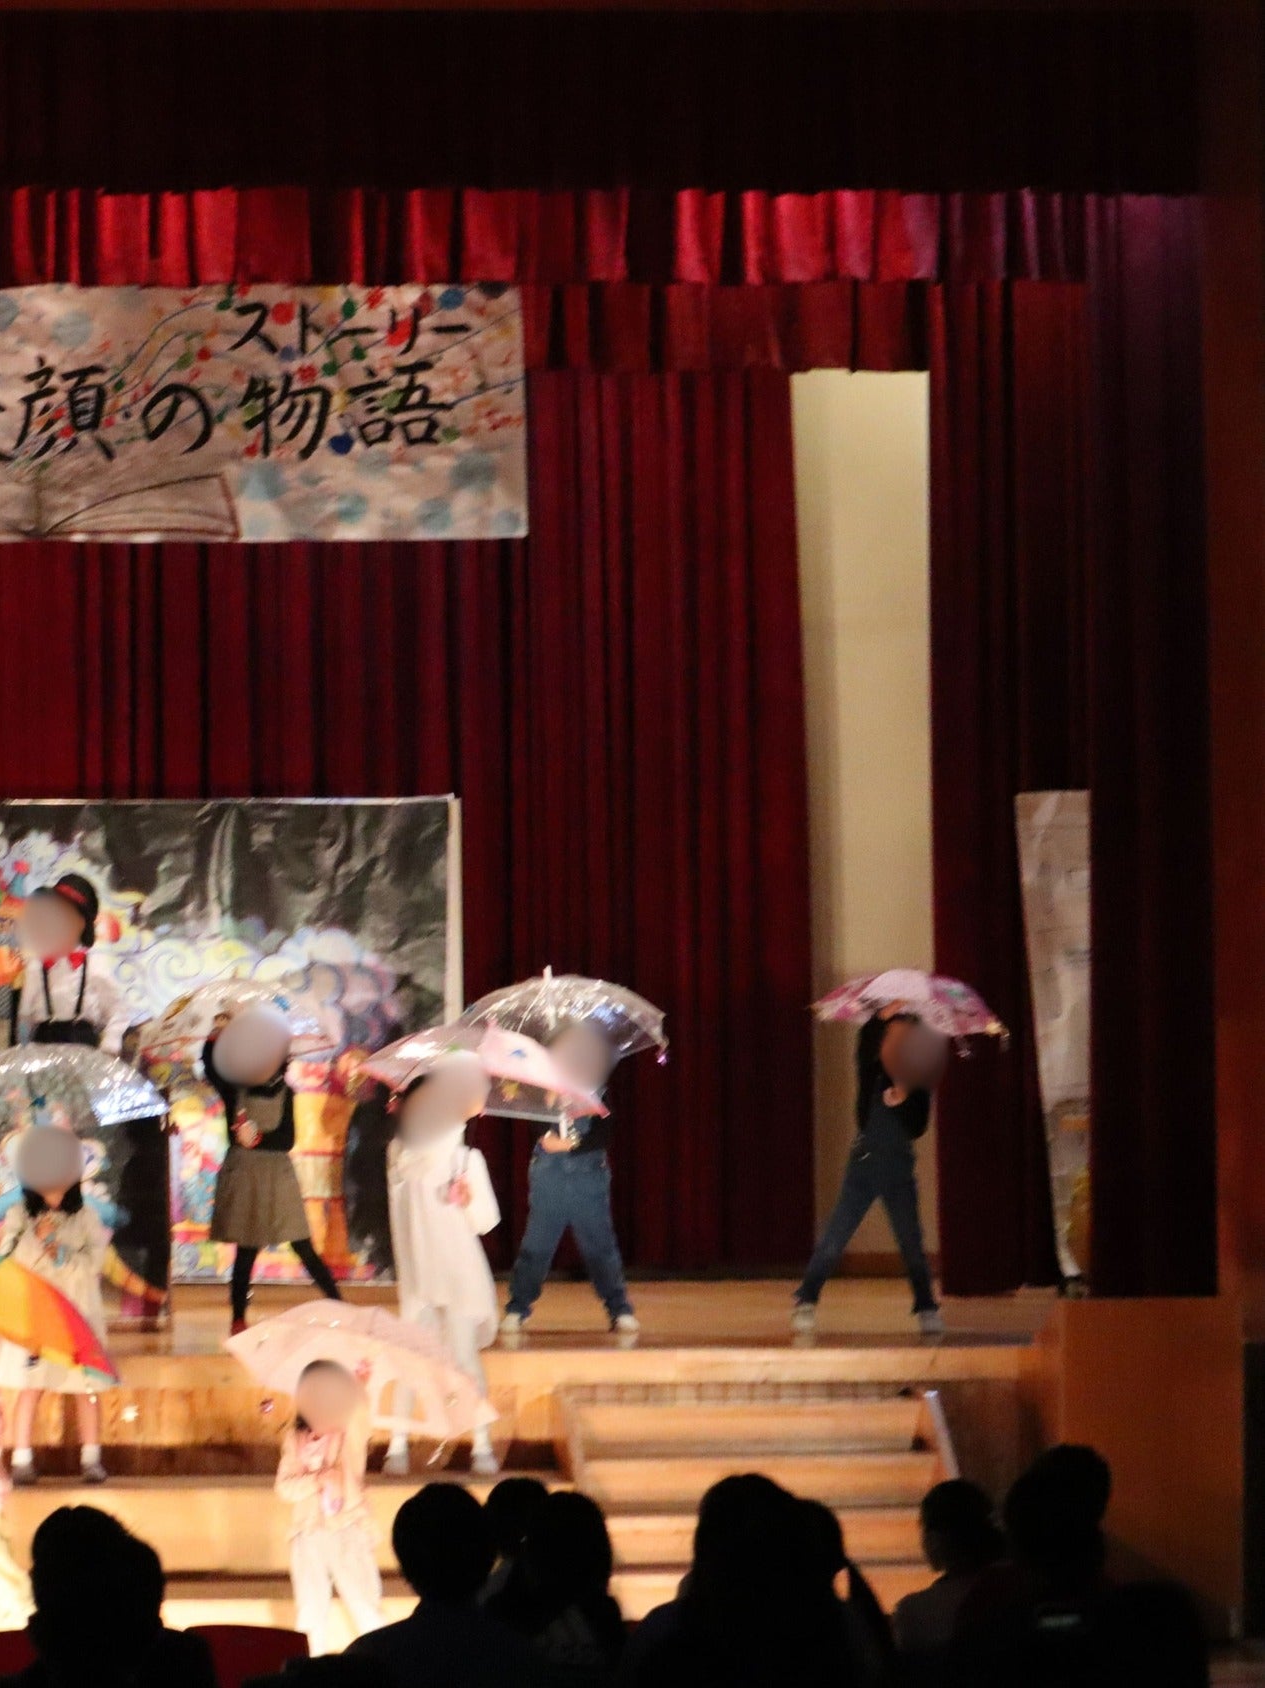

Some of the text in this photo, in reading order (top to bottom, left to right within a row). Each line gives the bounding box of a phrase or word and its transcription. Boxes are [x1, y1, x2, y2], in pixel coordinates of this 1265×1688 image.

[228, 302, 471, 355] ストーリー
